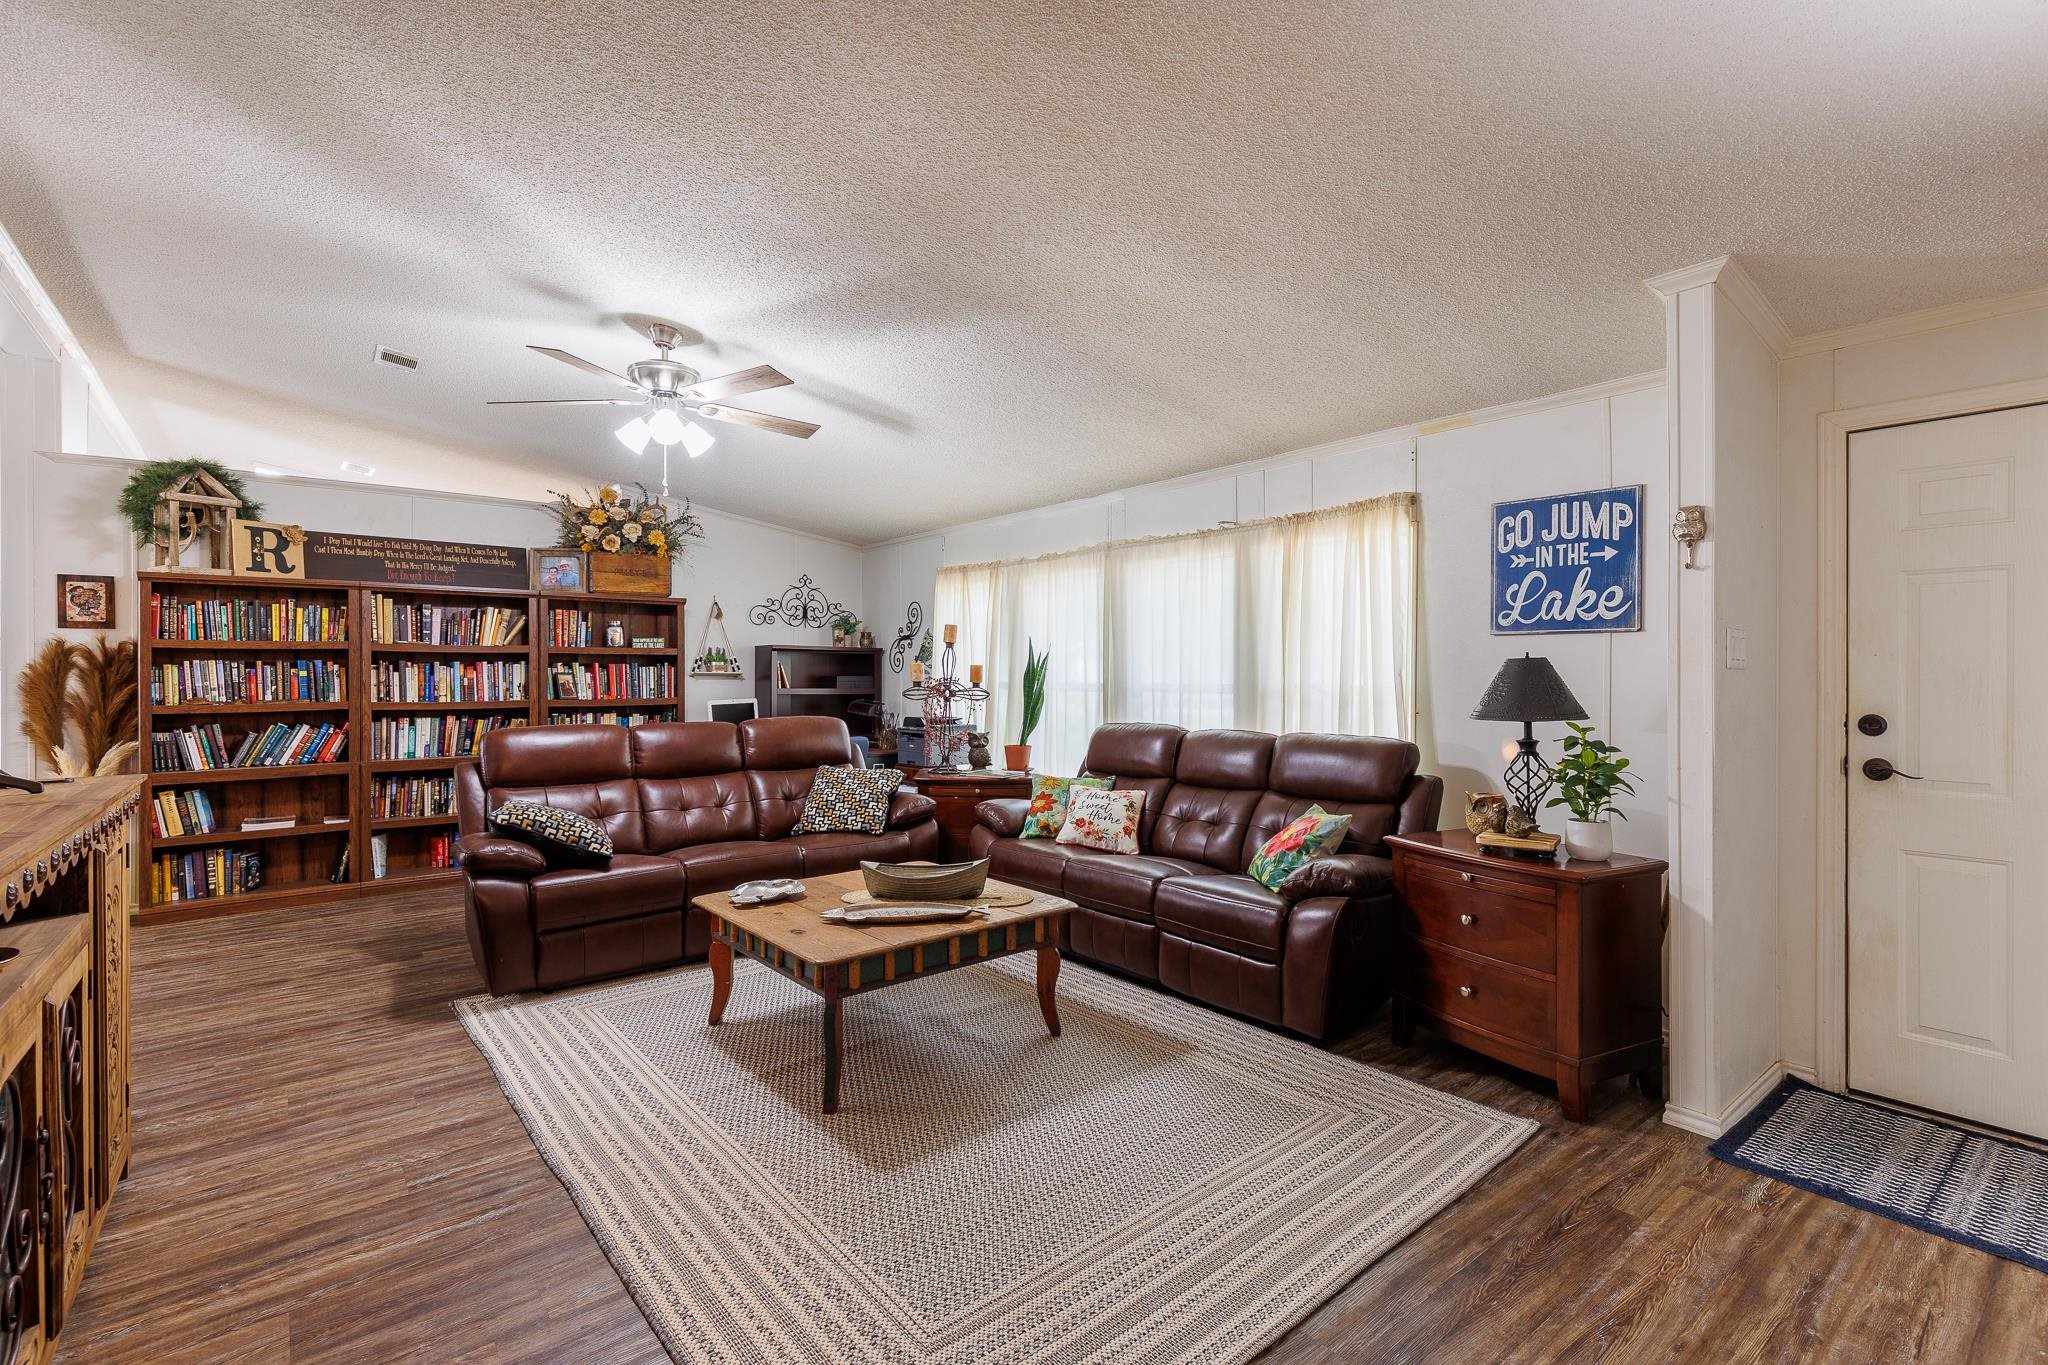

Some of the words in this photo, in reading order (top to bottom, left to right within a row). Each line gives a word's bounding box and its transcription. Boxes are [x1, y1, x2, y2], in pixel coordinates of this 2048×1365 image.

[1498, 509, 1534, 554] GO
[1541, 501, 1633, 542] JUMP
[243, 525, 296, 574] R
[1535, 545, 1553, 568] IN
[1556, 541, 1589, 567] THE
[1498, 566, 1633, 627] Lake
[1078, 801, 1113, 814] Sweet
[1085, 791, 1121, 803] Home
[1086, 809, 1122, 824] Home
